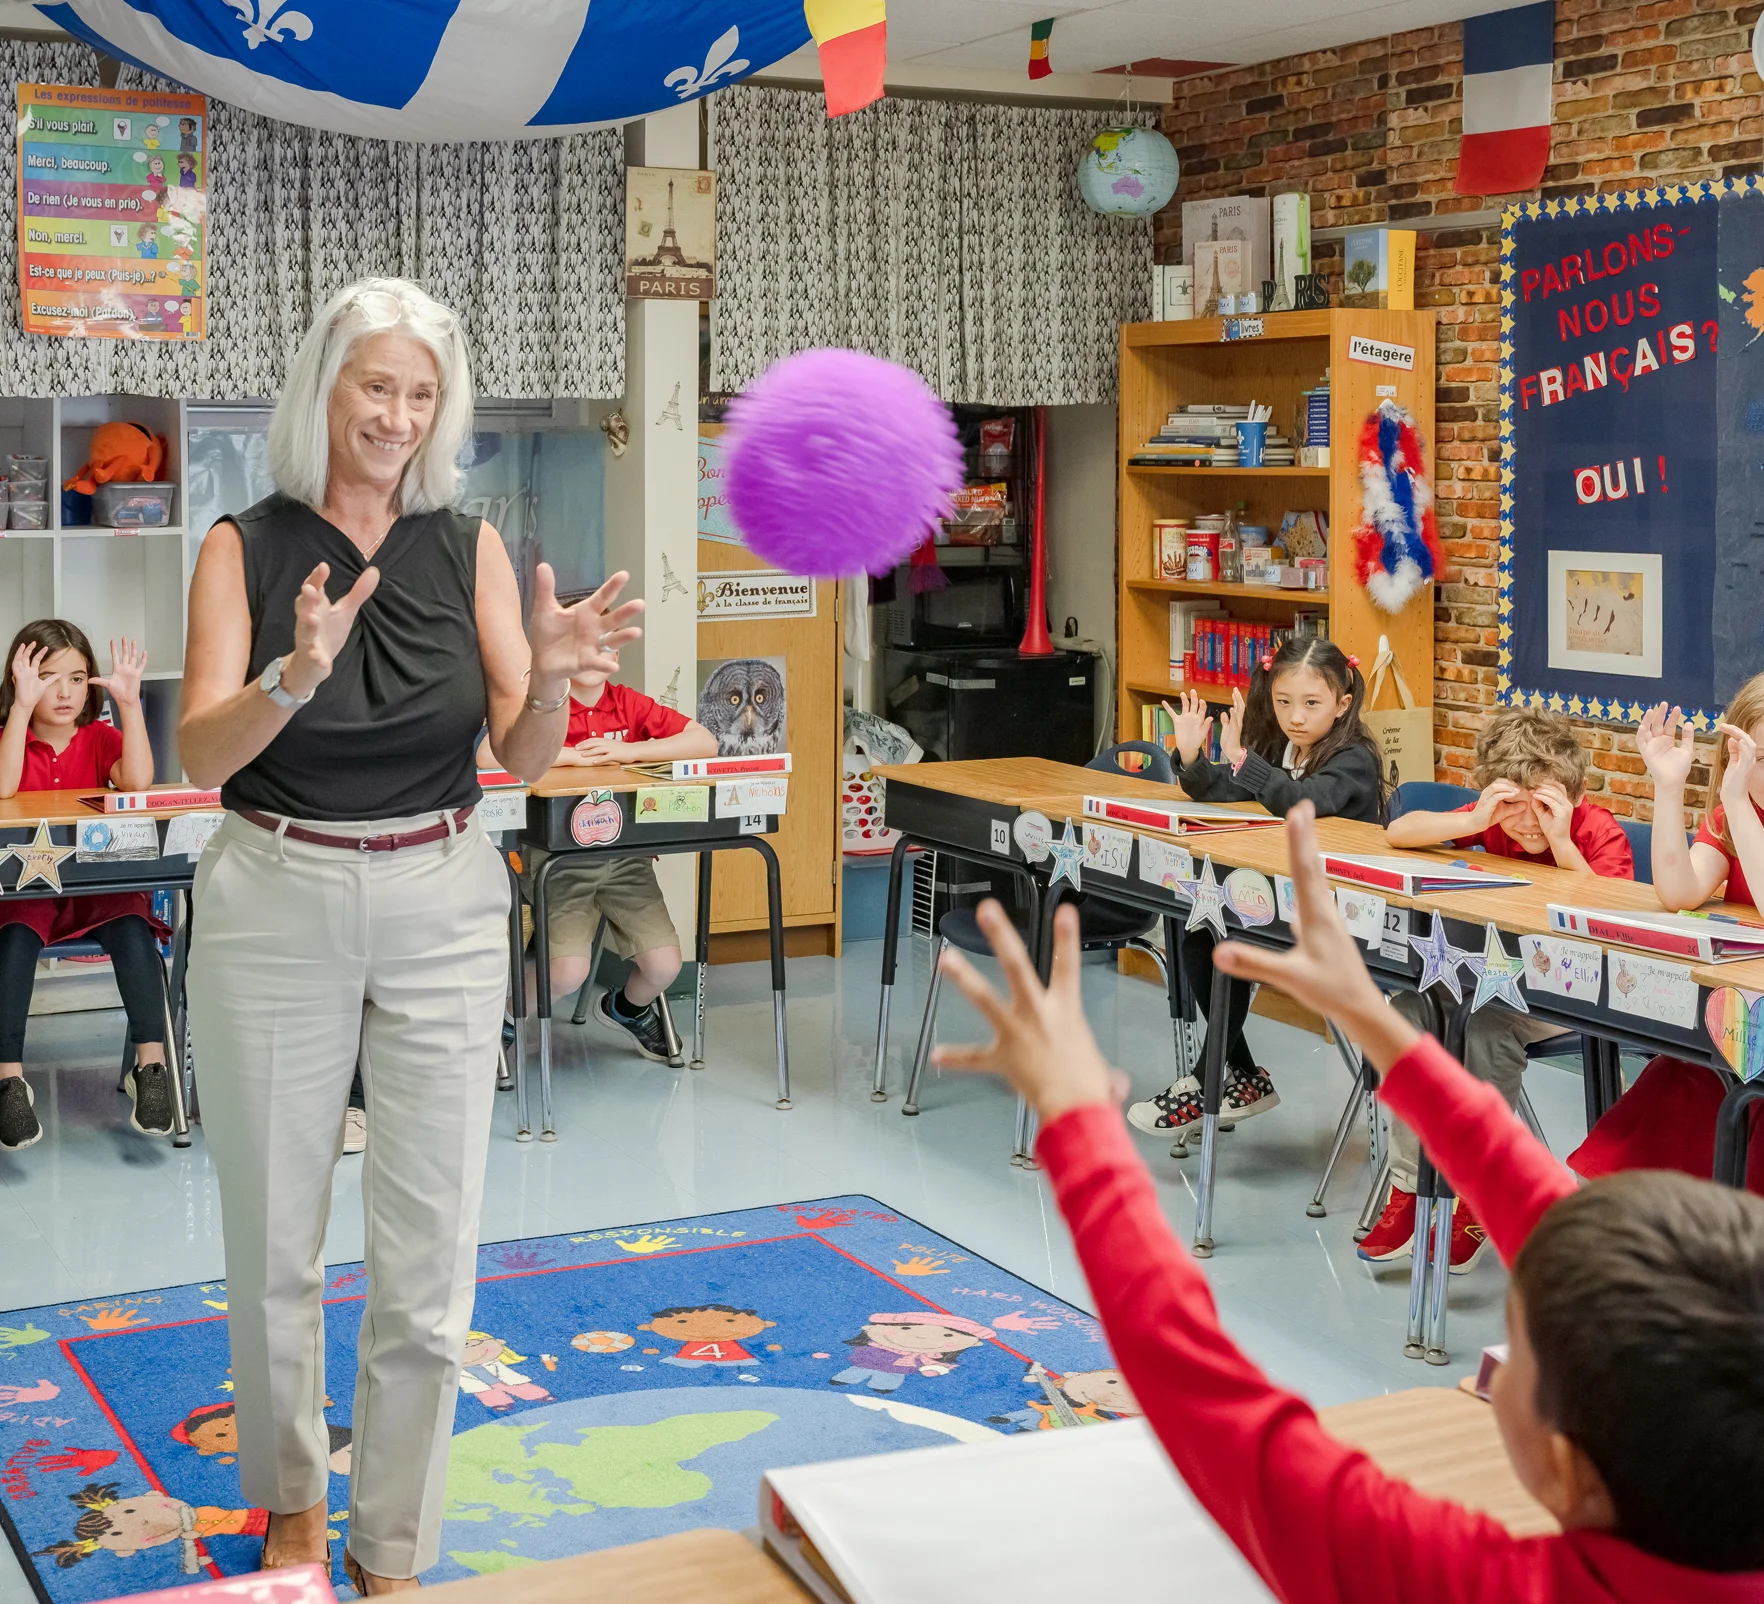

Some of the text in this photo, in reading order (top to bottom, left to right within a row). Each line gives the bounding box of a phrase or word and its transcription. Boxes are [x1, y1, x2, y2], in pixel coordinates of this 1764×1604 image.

[34, 89, 191, 110] Les expressions de politesse
[28, 117, 43, 130] S'il
[46, 120, 69, 132] vous
[27, 155, 111, 173] Merci, beaucoup.
[28, 192, 143, 212] De rien (Je vous en prie).
[1219, 205, 1241, 218] PARIS
[28, 229, 87, 245] Non, merci.
[1219, 246, 1238, 254] PARIS
[29, 264, 54, 278] Est-ce
[57, 267, 72, 280] que
[74, 267, 83, 281] je
[85, 269, 106, 282] peux
[640, 281, 701, 295] PARIS
[31, 303, 89, 318] Excusez-moi
[1557, 282, 1661, 342] NOUS
[1241, 322, 1260, 335] livres
[1353, 341, 1412, 363] l'étagère
[1574, 457, 1646, 505] OUI
[715, 581, 808, 598] Bienvenue
[716, 596, 808, 608] à la classe de français
[1385, 736, 1399, 745] de la
[748, 785, 786, 799] Nicholas
[481, 805, 504, 818] Josie
[744, 814, 762, 827] 14
[994, 828, 1006, 844] 10
[27, 853, 53, 864] Everly
[1353, 871, 1365, 881] Jack
[1383, 911, 1401, 933] 12
[1616, 930, 1635, 943] Ellie
[1560, 946, 1600, 963] Je m'appelle
[1647, 966, 1690, 983] Je m'appelle
[569, 1227, 747, 1244] RESPONSIBLE
[898, 1243, 972, 1263] POLITE
[951, 1287, 1023, 1302] HARD
[58, 1295, 162, 1317] CARING
[691, 1342, 727, 1360] 4
